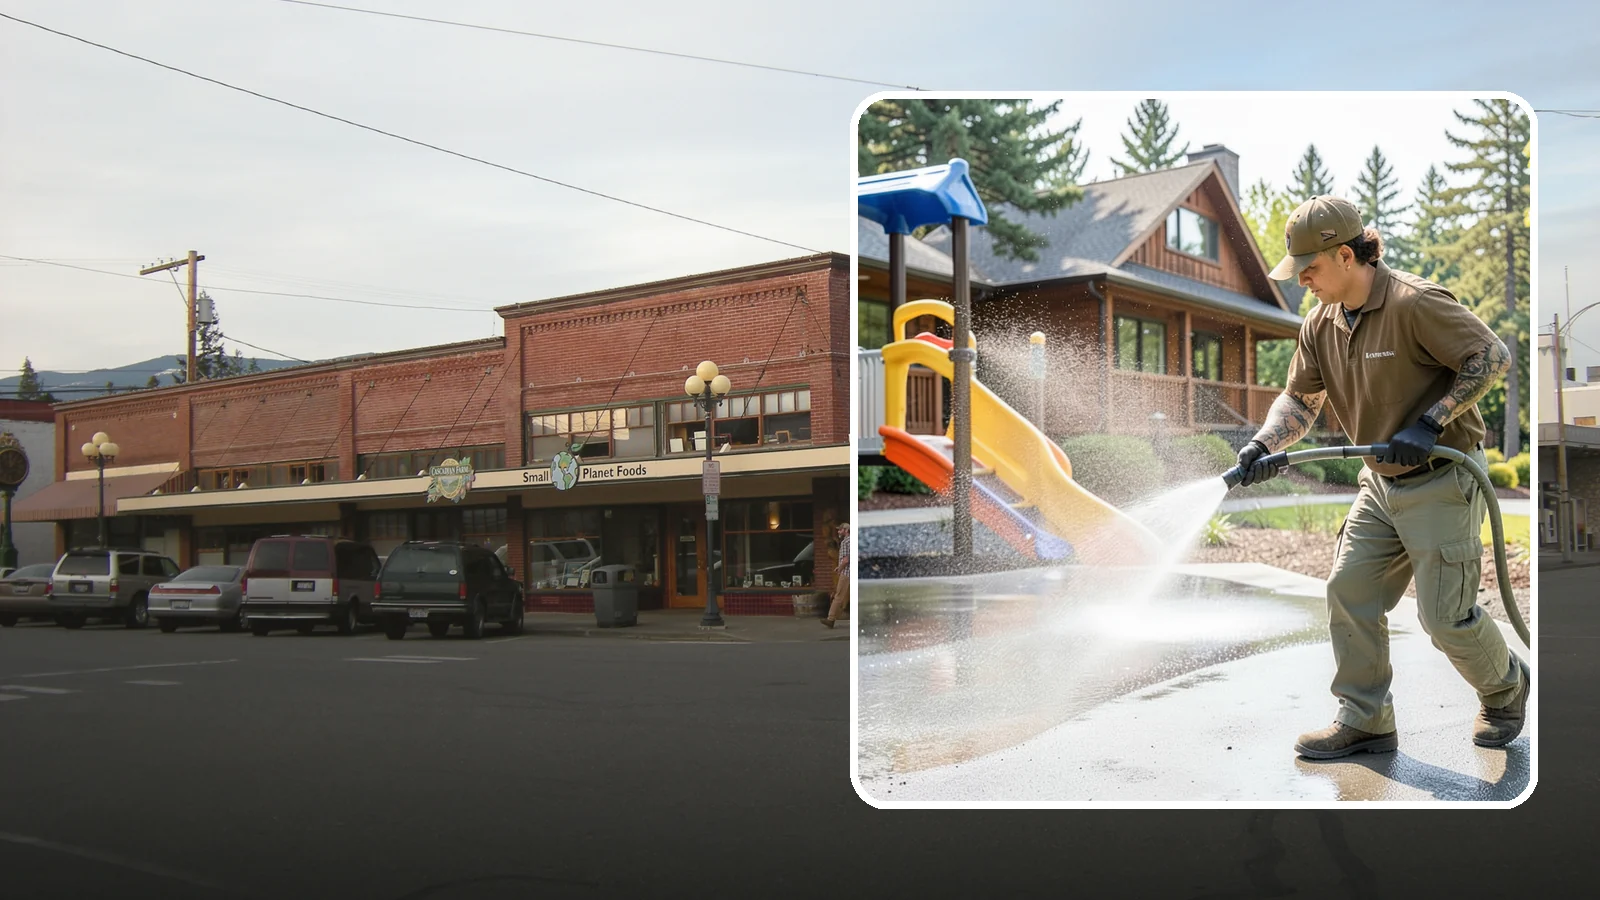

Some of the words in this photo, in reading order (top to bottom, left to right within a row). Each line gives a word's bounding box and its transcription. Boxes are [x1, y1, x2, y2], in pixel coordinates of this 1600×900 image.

[523, 471, 549, 483] Small
[584, 468, 614, 479] Planet
[617, 465, 647, 477] Foods
